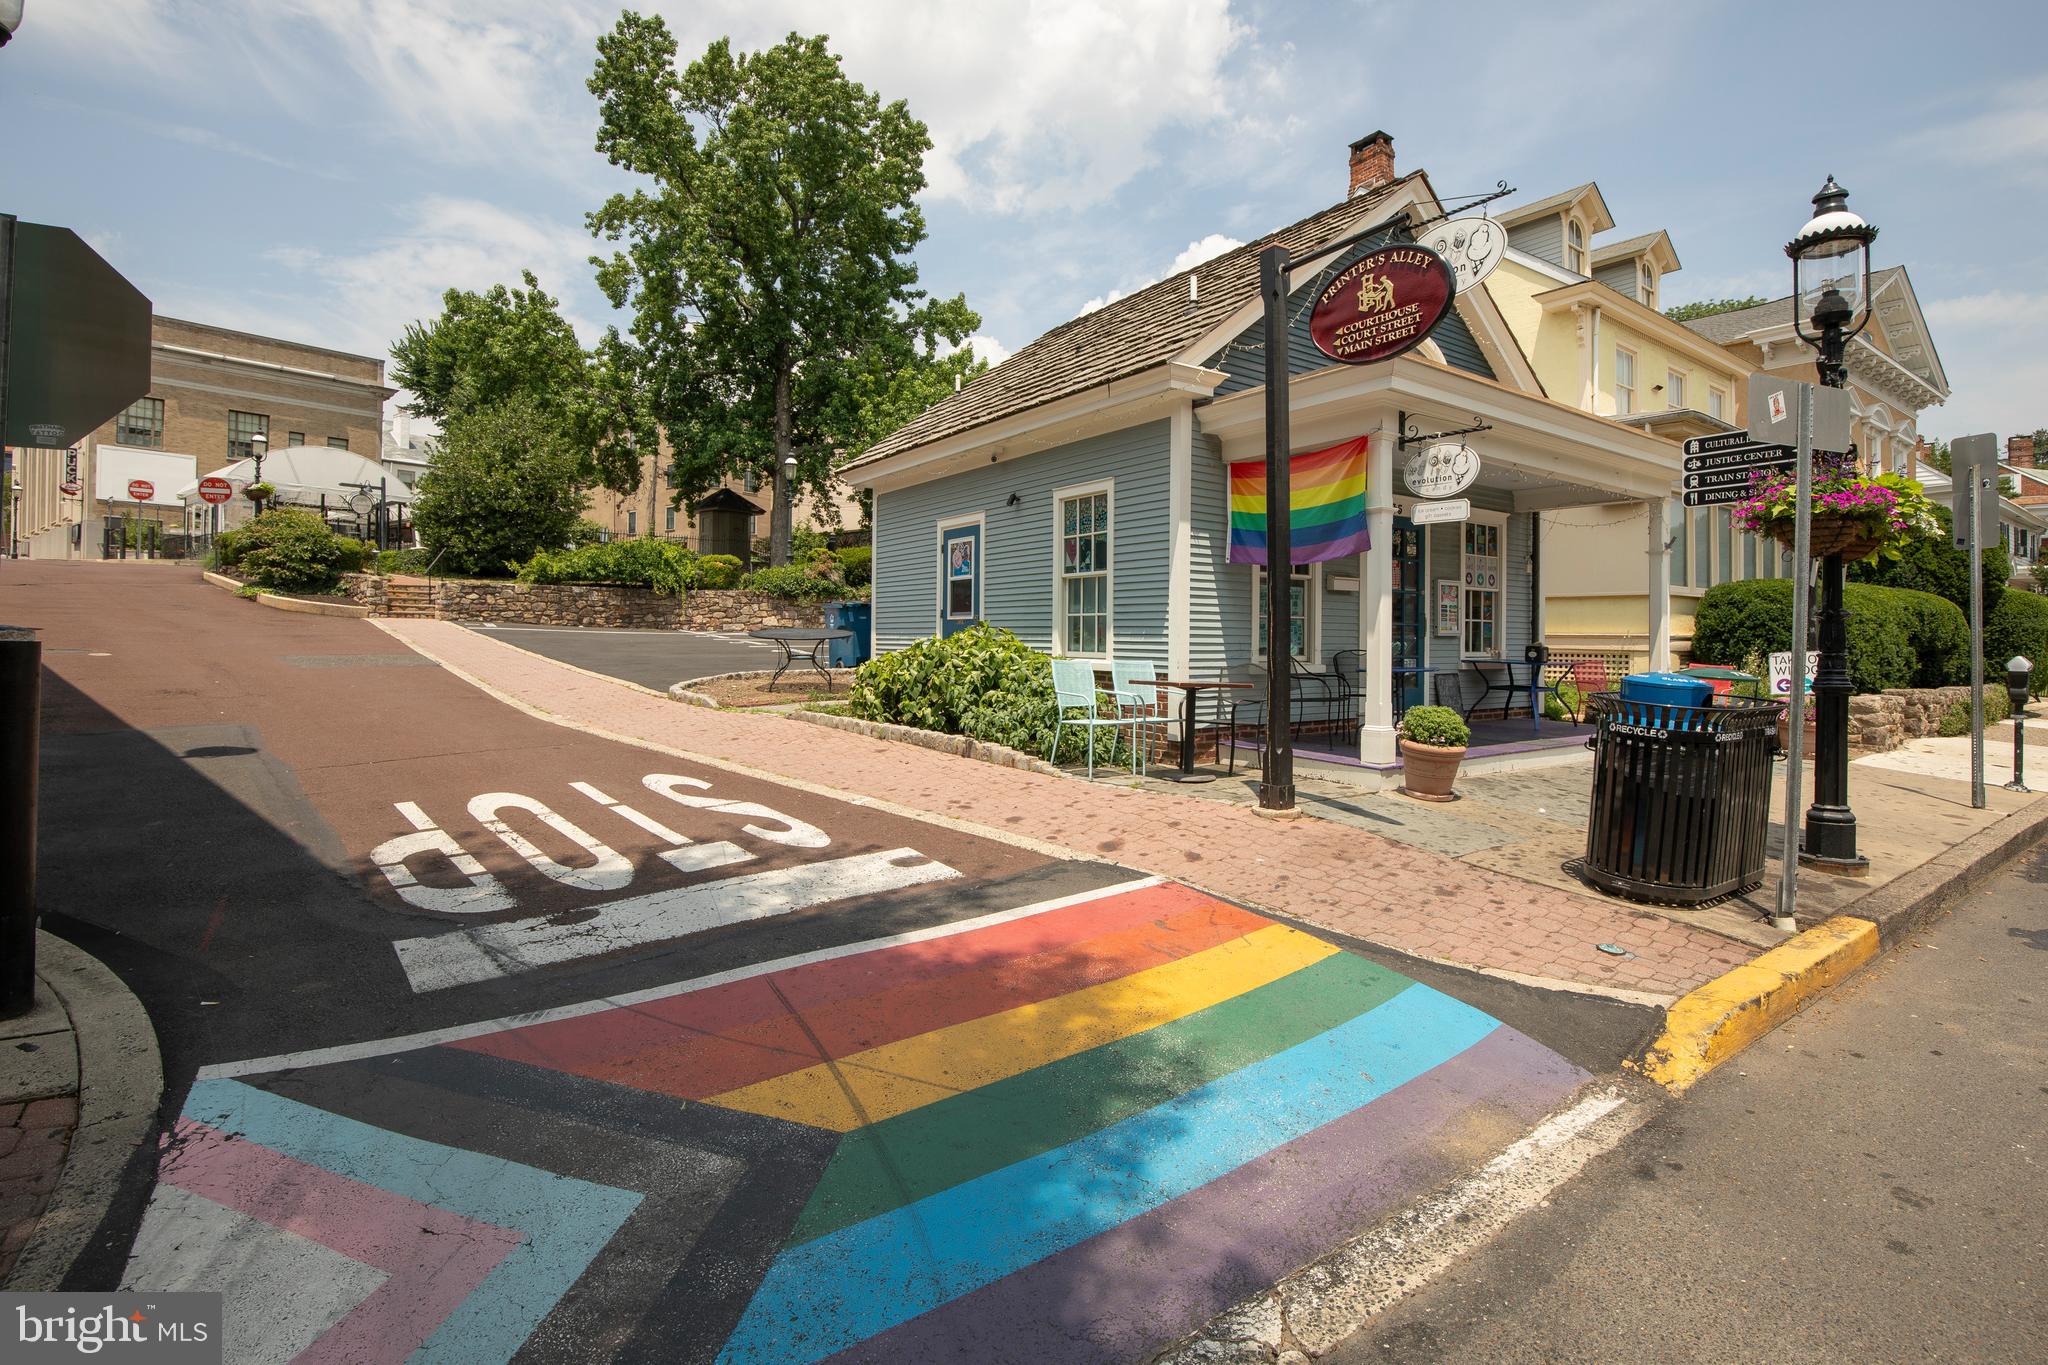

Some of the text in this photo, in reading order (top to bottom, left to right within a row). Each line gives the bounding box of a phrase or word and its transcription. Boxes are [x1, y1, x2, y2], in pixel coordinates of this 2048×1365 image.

[1321, 251, 1433, 305] PRINTER'S ALLEY
[1341, 312, 1423, 345] COURT STREET
[1343, 302, 1420, 333] COURTHOUSE
[1344, 325, 1417, 355] MAIN STREET
[1705, 436, 1745, 449] CULTURAL
[66, 449, 77, 483] PUCK
[1705, 449, 1783, 467] JUSTICE CENTER
[1412, 474, 1453, 485] evolution
[1705, 467, 1778, 484] TRAIN STAION
[1705, 490, 1738, 501] DINING
[1740, 489, 1747, 497] &
[1616, 723, 1658, 739] RECYCLE
[369, 773, 832, 914] STOP
